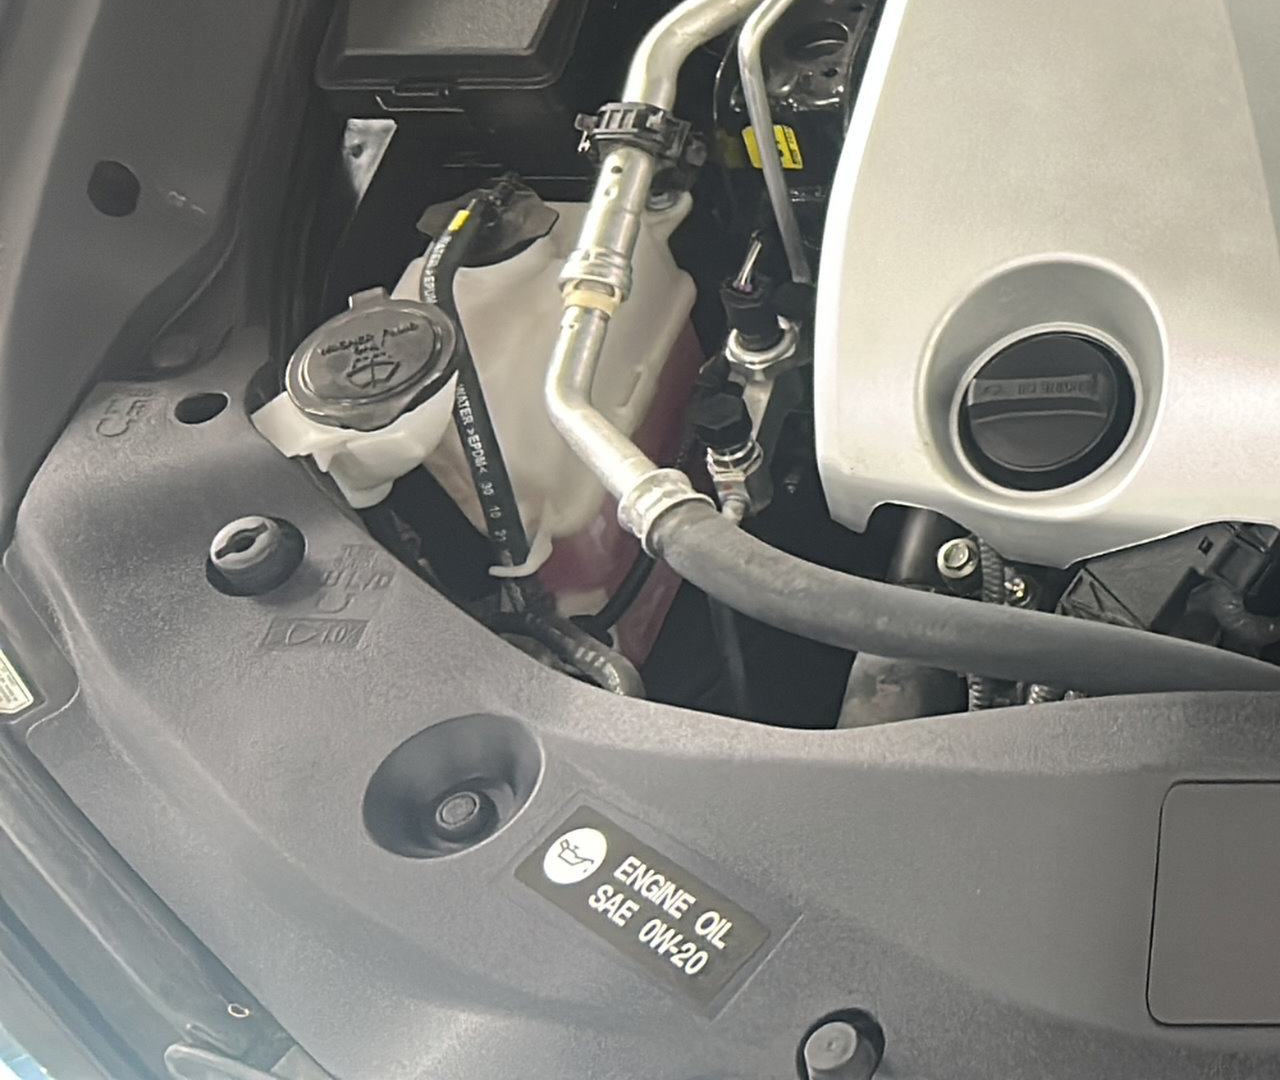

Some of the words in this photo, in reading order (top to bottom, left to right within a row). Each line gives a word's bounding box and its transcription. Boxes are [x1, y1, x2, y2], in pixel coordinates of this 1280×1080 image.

[456, 383, 473, 424] WATER
[588, 884, 640, 927] SAE
[638, 918, 709, 975] 0W-20
[613, 855, 697, 920] ENGINE
[694, 910, 733, 950] OIL
